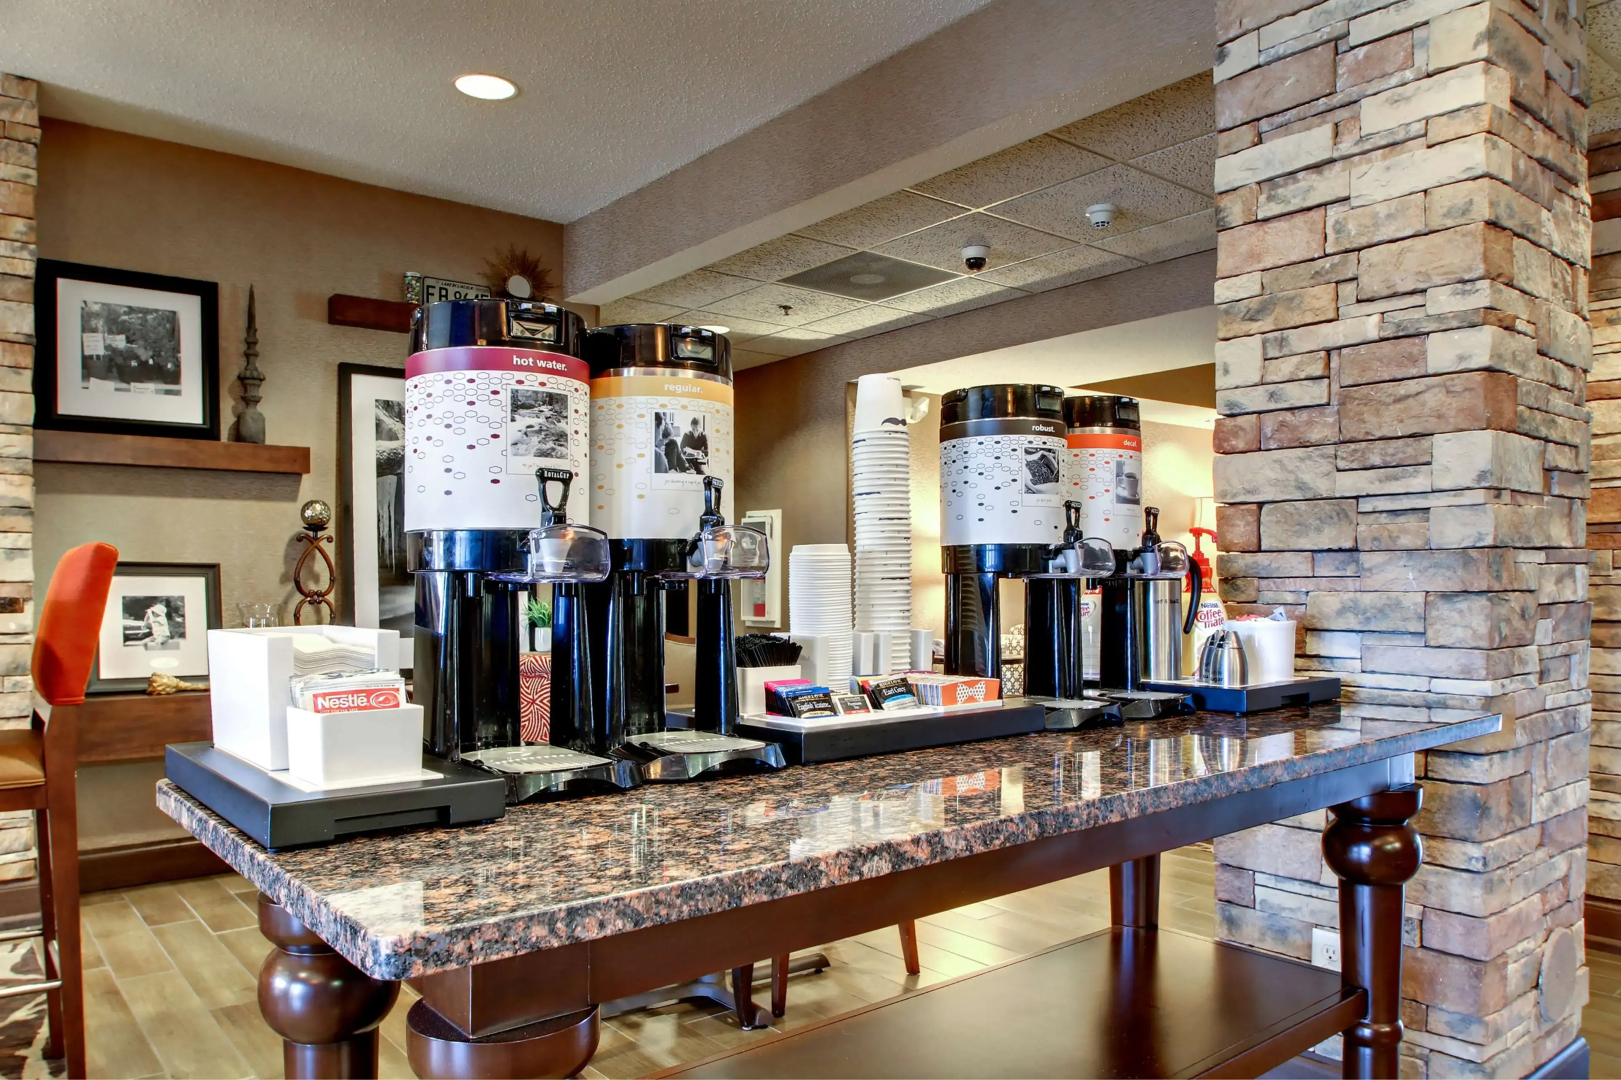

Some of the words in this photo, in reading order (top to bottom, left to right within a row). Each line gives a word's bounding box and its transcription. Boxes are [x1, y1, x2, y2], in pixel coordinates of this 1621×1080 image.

[512, 354, 534, 366] hot
[536, 359, 568, 371] water.
[664, 383, 703, 394] regular.
[1031, 424, 1055, 433] robust.
[882, 687, 895, 696] Earl
